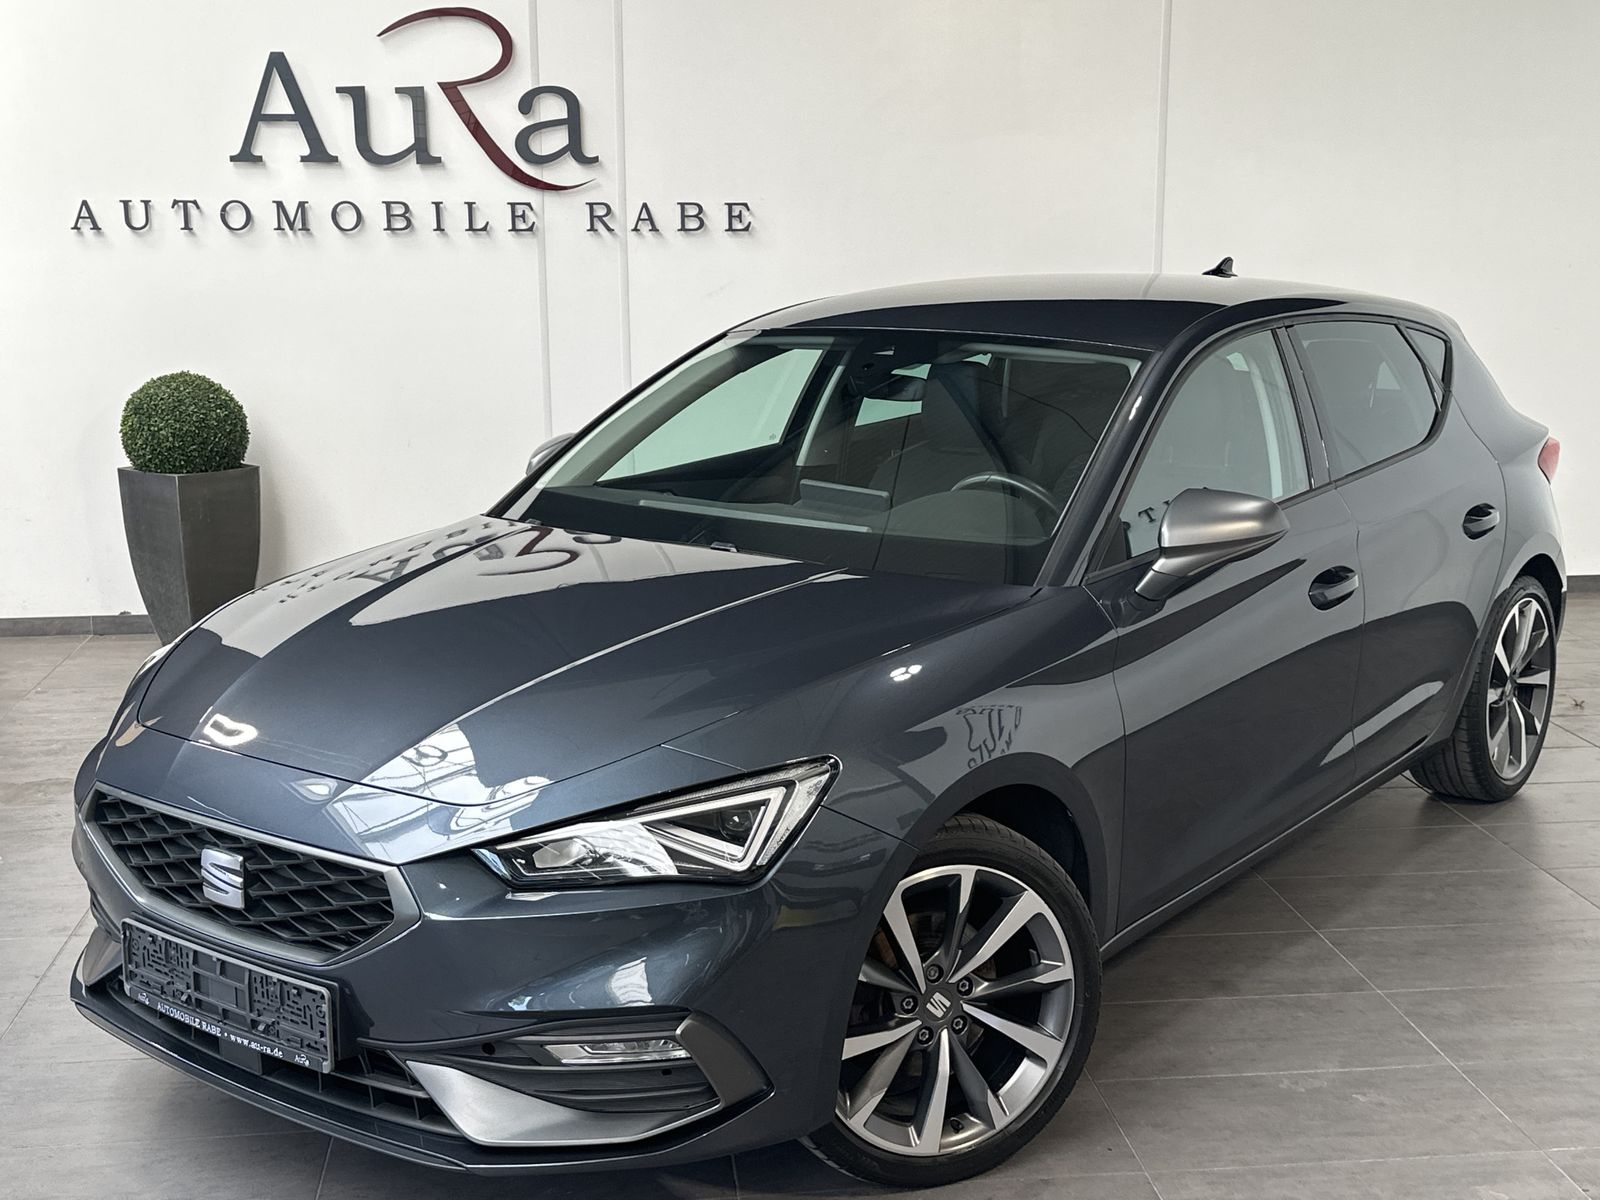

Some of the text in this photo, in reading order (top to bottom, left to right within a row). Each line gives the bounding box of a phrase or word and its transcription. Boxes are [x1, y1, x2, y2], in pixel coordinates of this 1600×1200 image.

[230, 7, 599, 191] AuRa
[71, 200, 751, 232] AUTOMOBILE RABE
[157, 1002, 201, 1028] AUTOMOBILE
[201, 1021, 222, 1036] RABE
